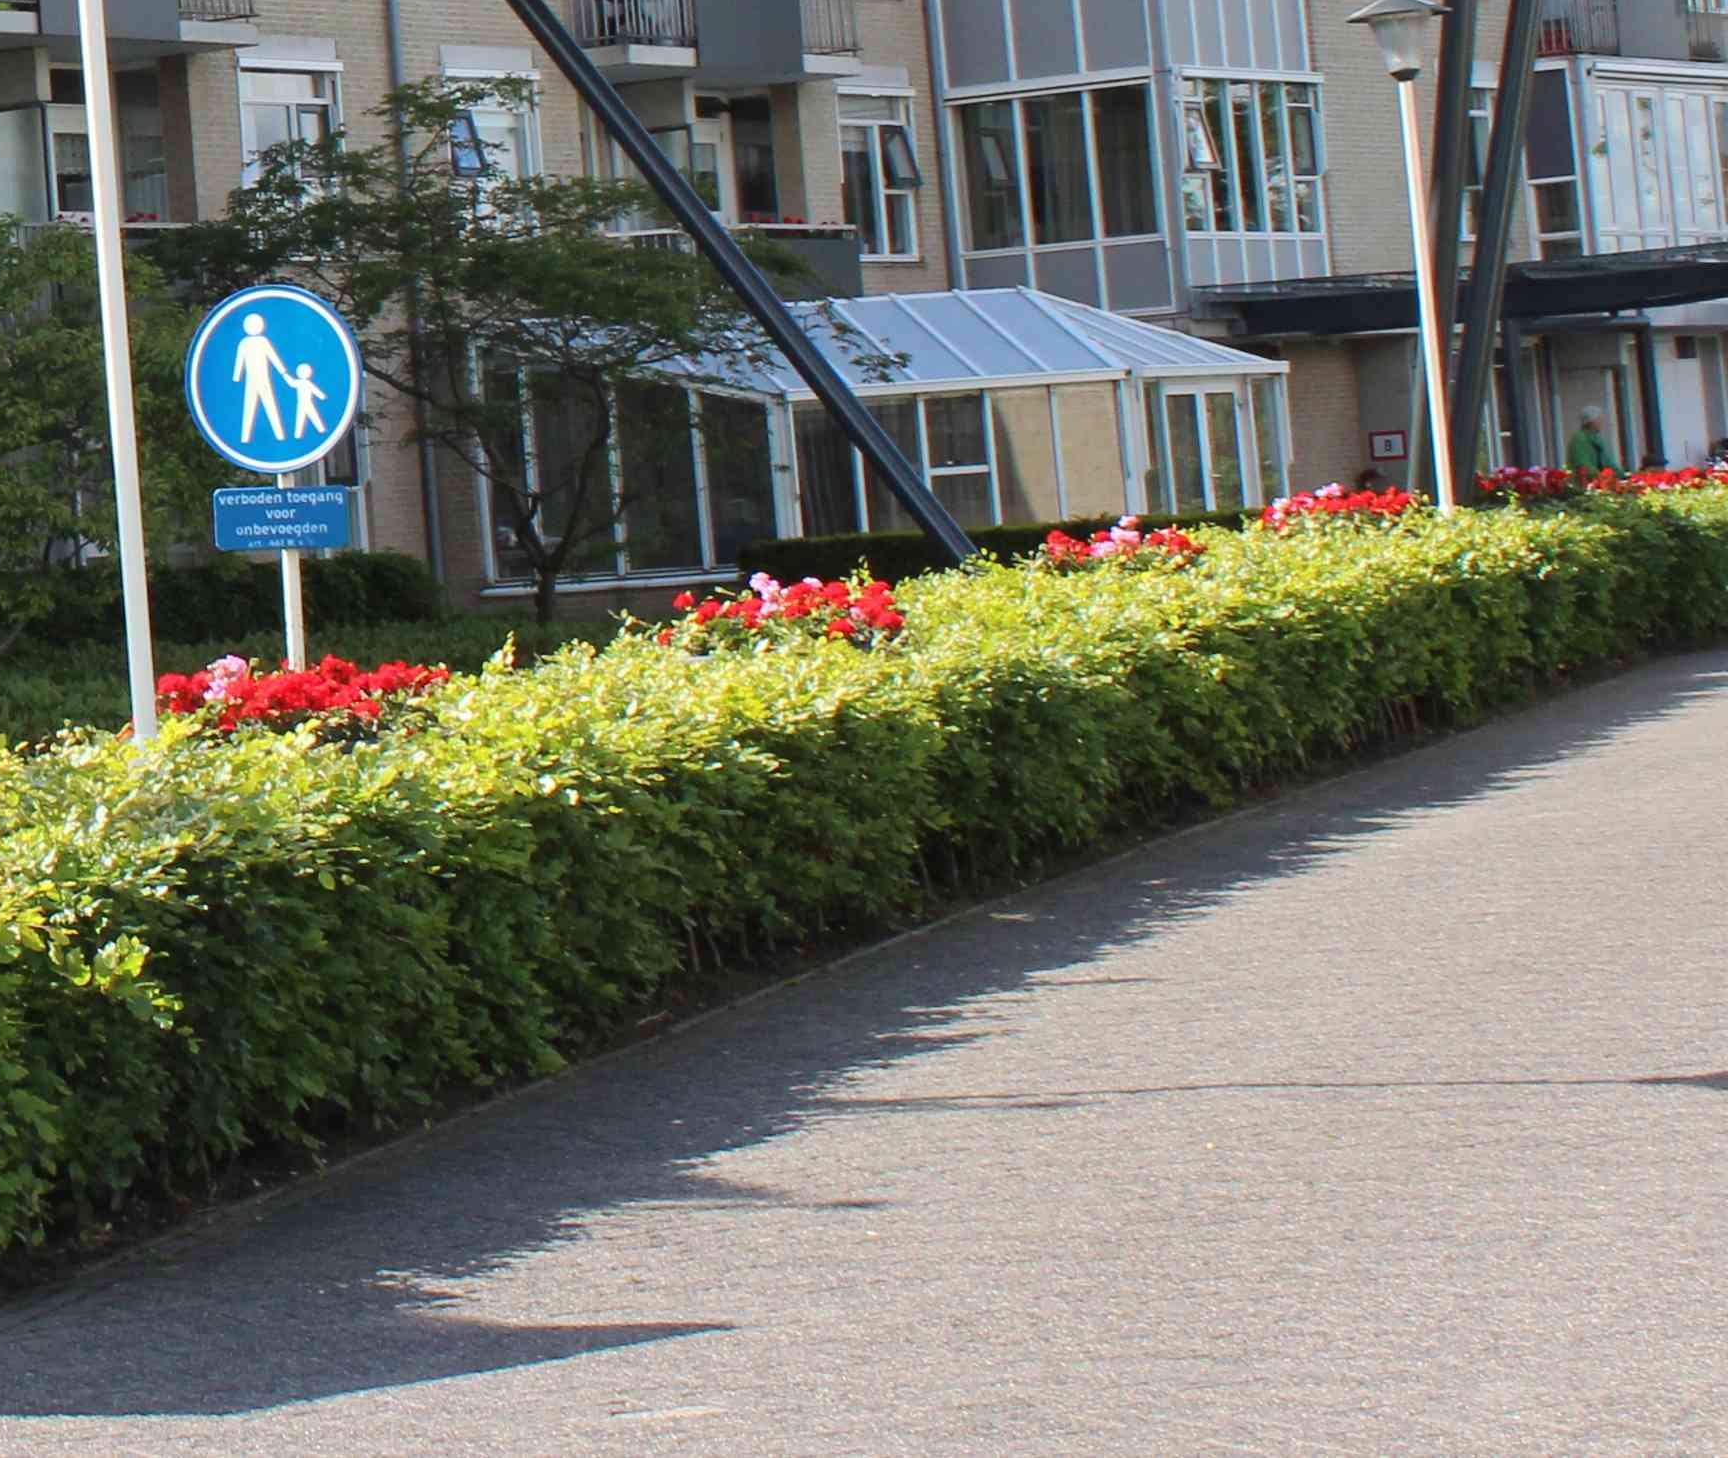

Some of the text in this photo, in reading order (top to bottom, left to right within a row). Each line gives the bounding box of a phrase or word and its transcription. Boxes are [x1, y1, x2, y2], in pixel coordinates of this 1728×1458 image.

[218, 491, 344, 506] verboden toegang
[264, 508, 297, 519] voor
[235, 522, 328, 537] onbevoegden
